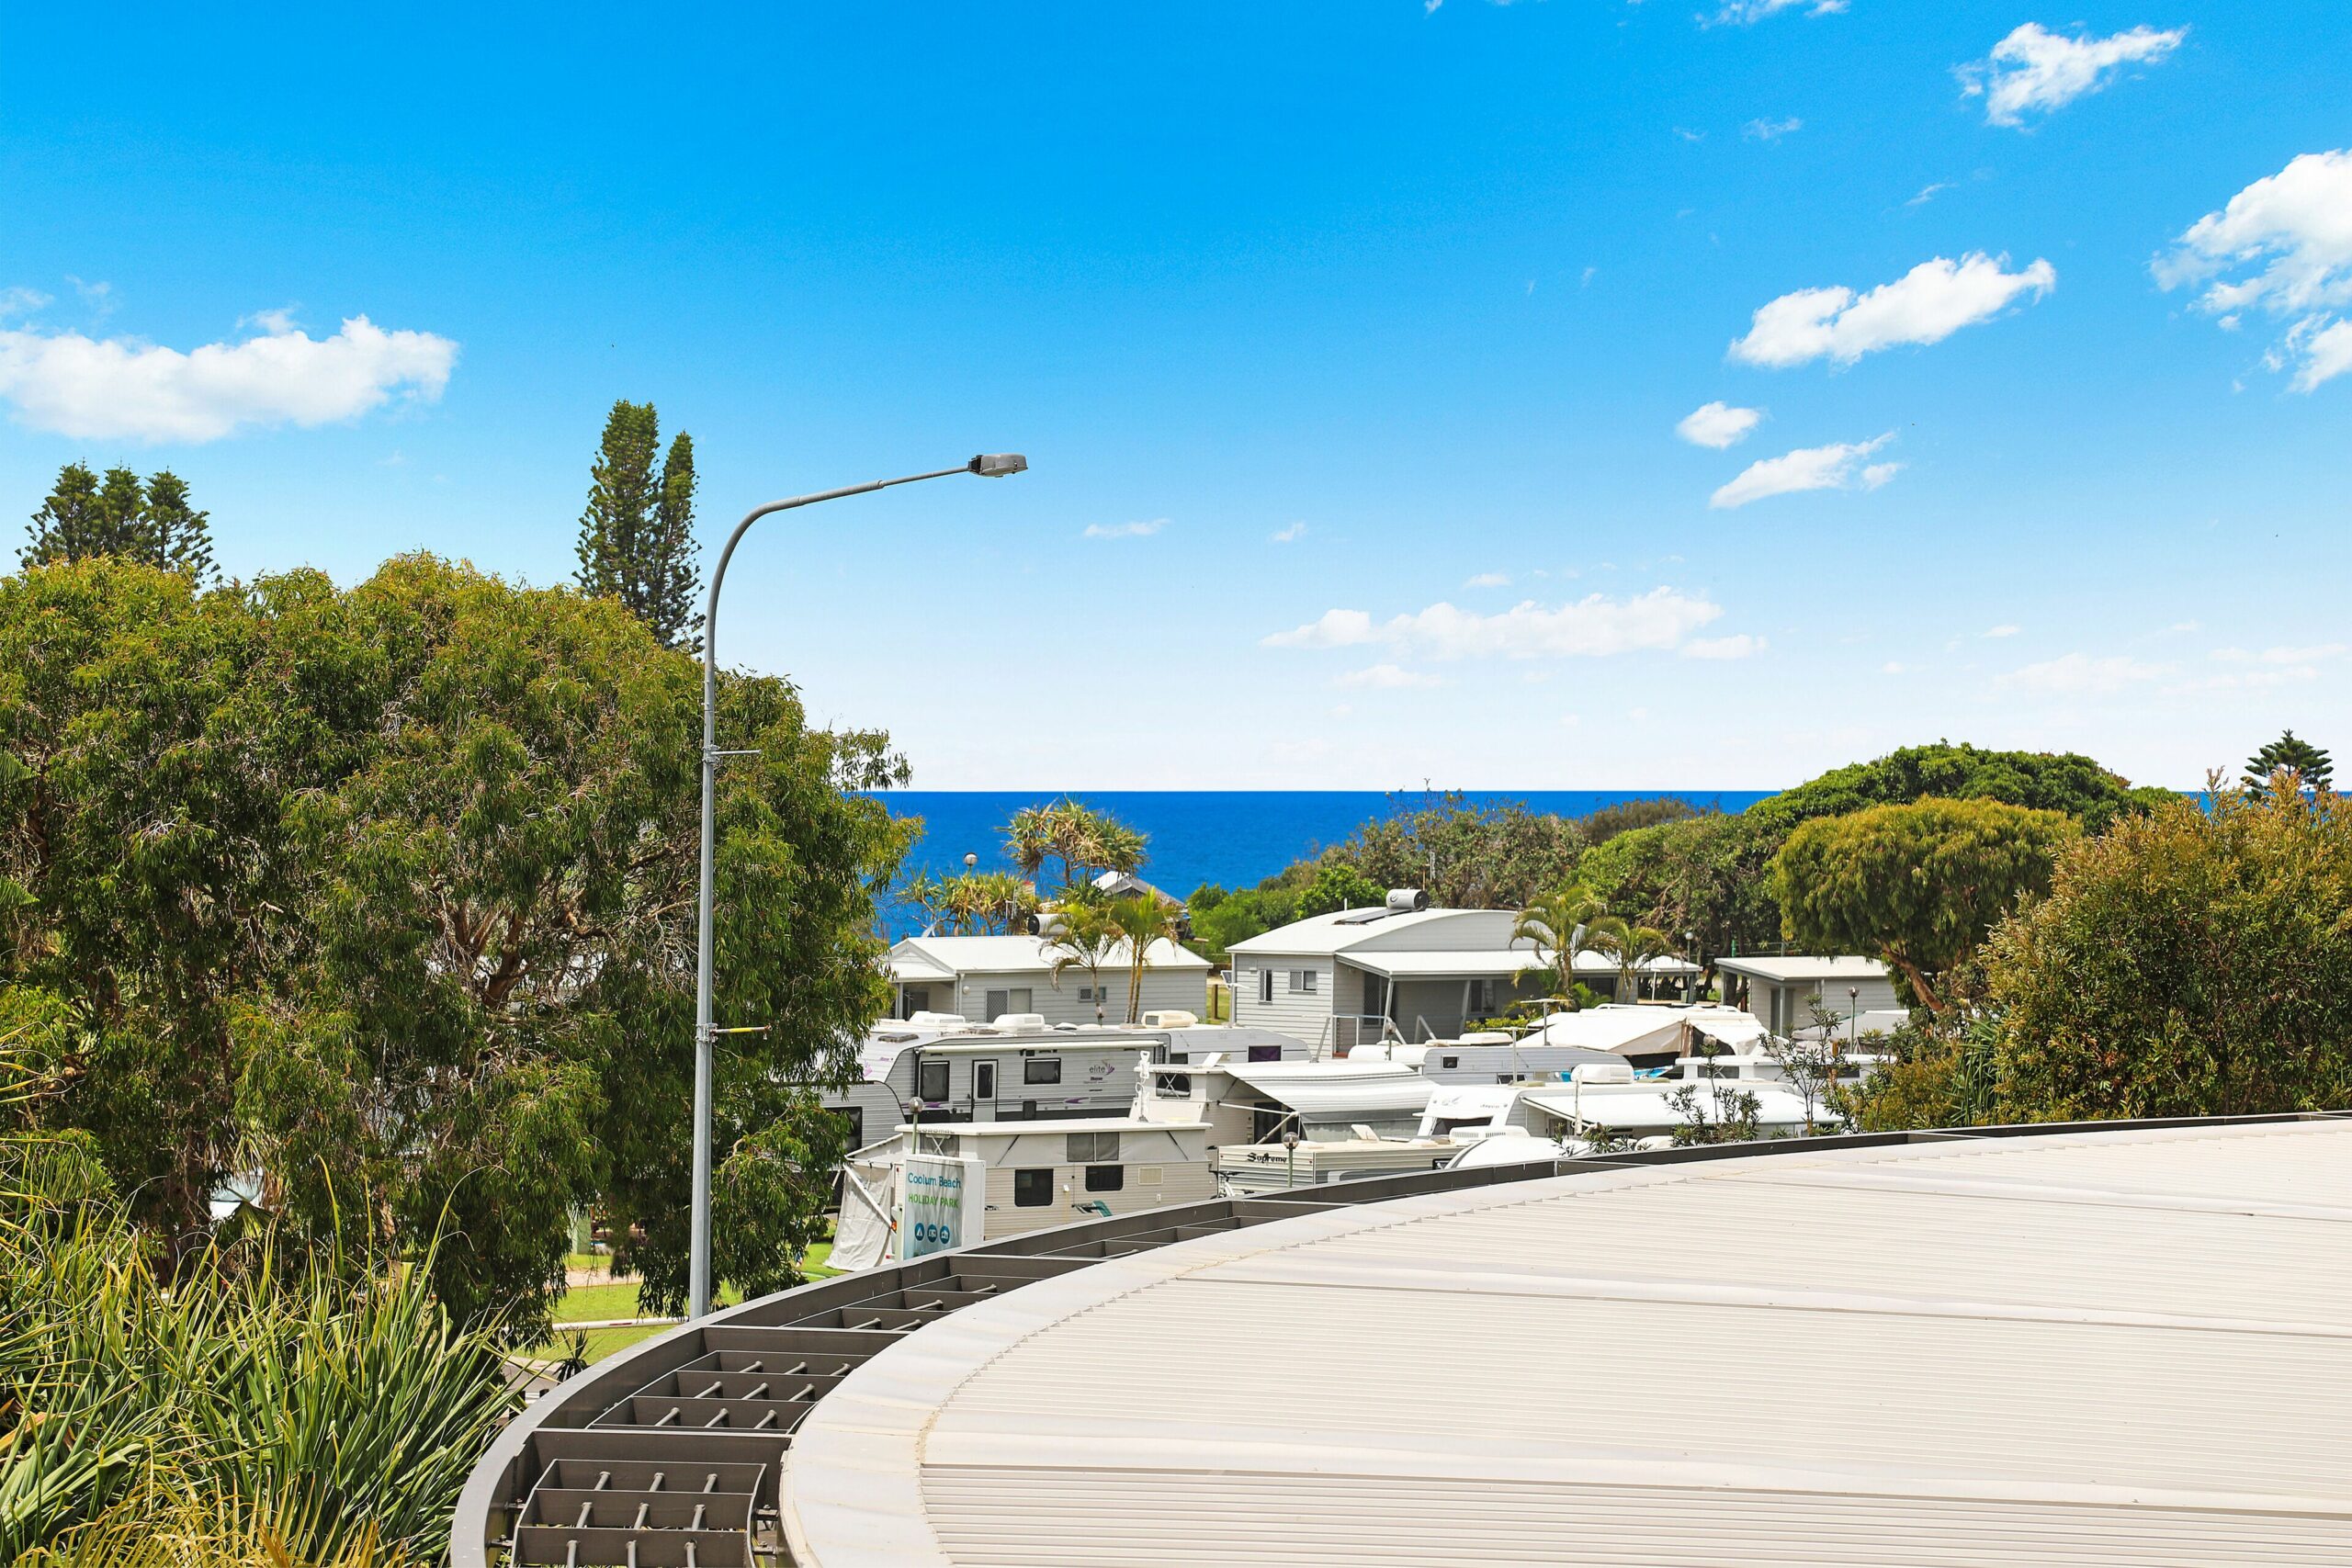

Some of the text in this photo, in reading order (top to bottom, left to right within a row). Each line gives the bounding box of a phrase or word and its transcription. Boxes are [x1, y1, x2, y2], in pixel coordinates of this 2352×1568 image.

[908, 1172, 962, 1190] Coolum Beach
[909, 1193, 960, 1209] HOLIDAY PARK
